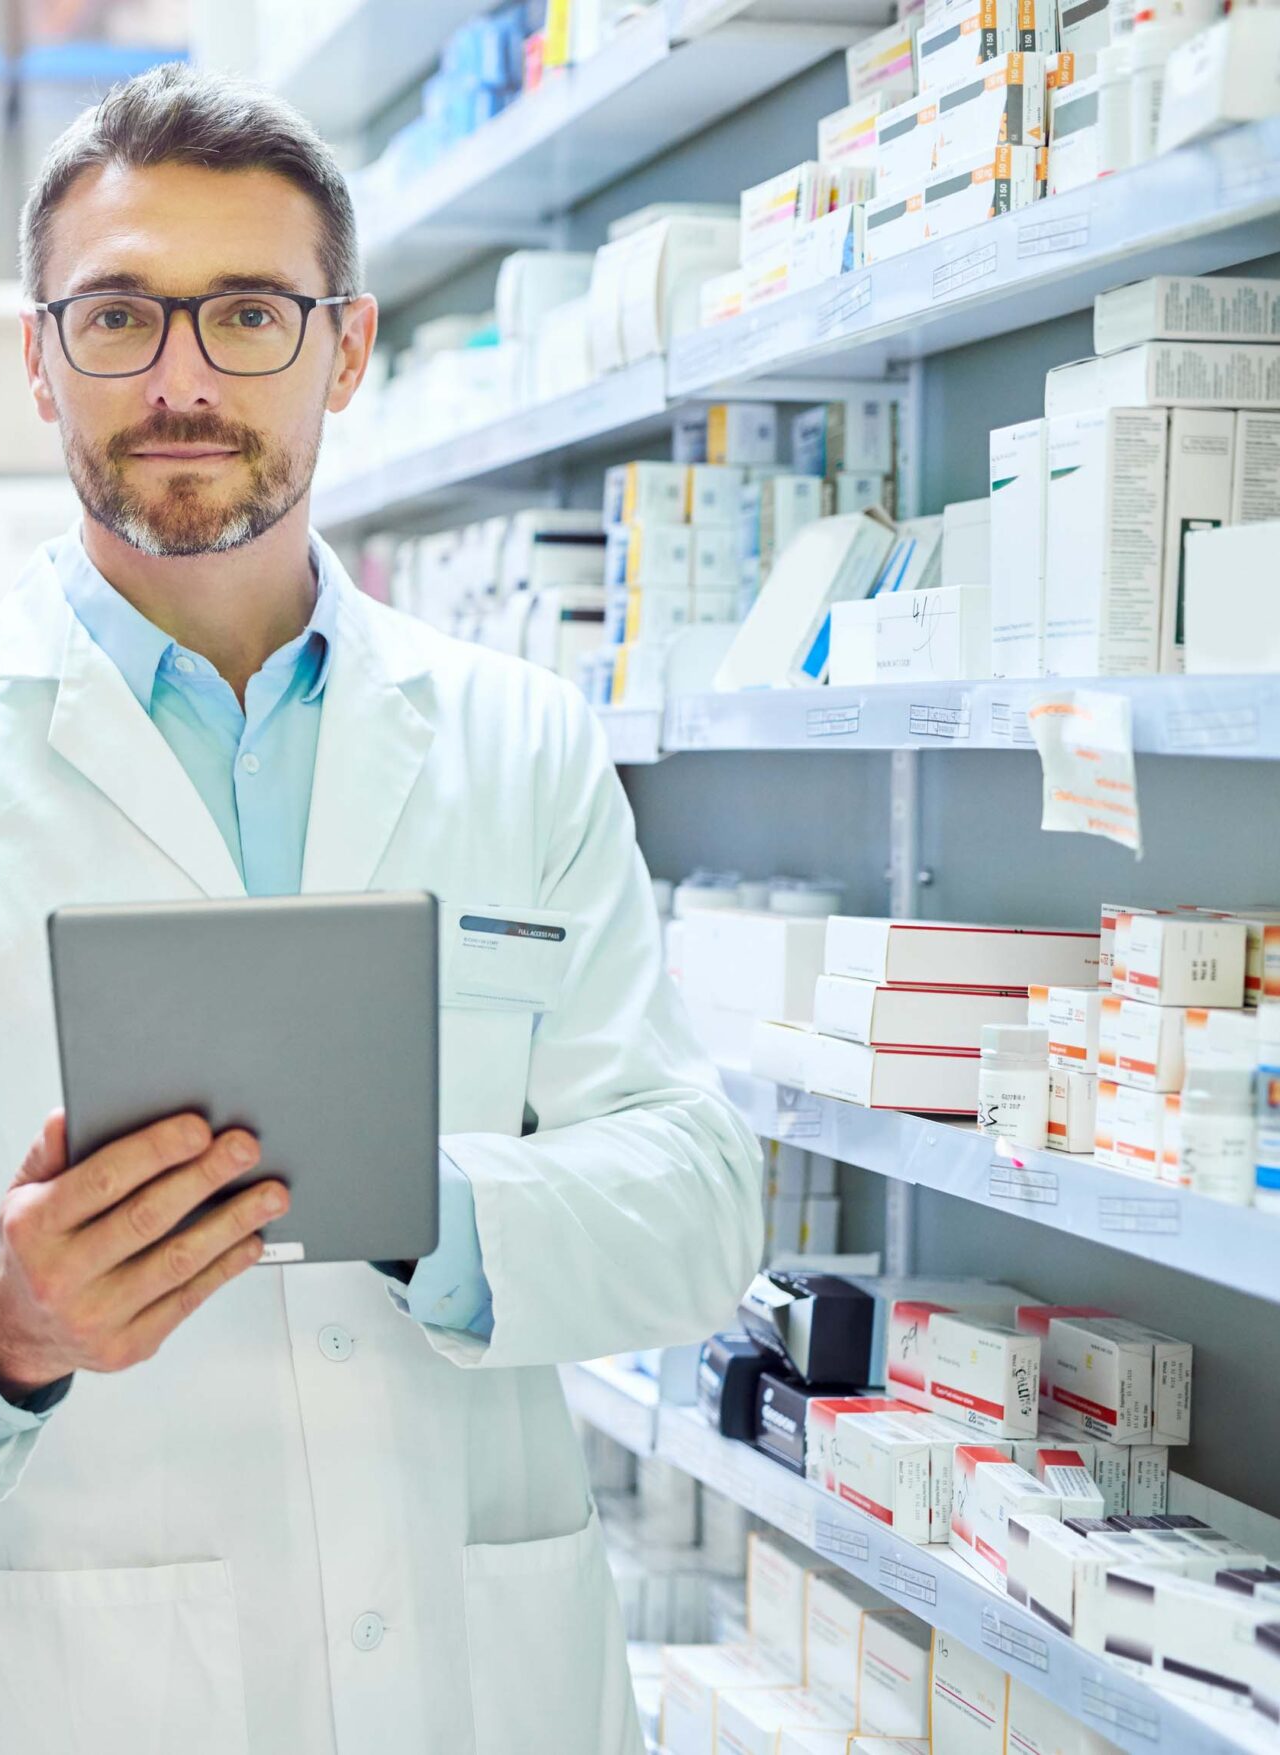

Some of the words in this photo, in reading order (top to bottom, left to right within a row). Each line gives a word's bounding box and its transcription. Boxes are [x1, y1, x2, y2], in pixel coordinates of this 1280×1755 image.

[986, 32, 995, 47] 150
[1024, 34, 1032, 48] 150
[999, 183, 1008, 198] 150
[518, 928, 529, 937] FULL
[530, 930, 548, 938] ACCESS
[548, 932, 560, 940] PASS
